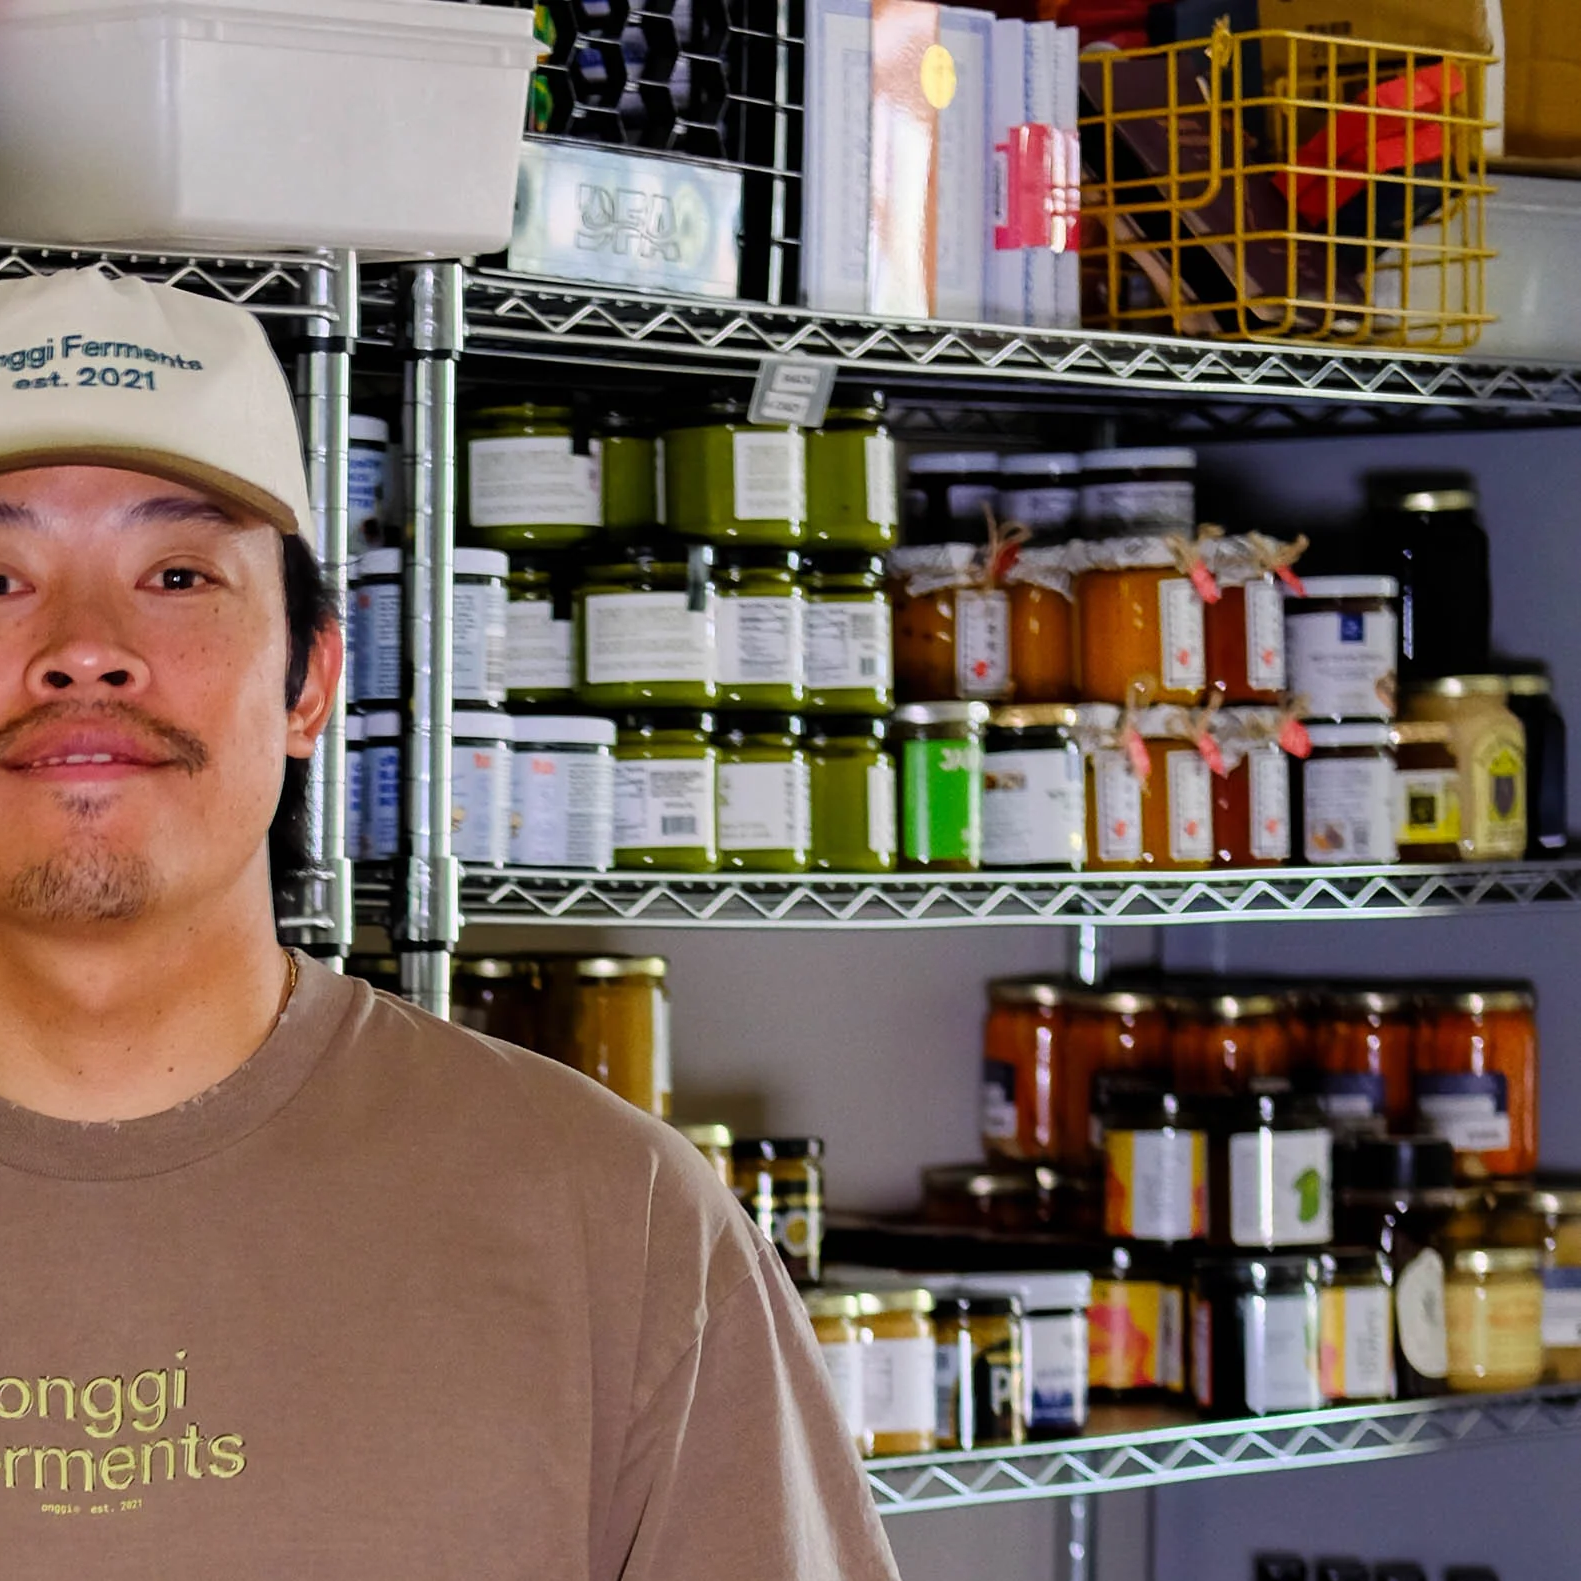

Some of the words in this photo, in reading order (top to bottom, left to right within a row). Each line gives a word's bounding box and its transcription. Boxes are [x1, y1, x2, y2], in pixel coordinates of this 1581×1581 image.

[61, 334, 204, 371] Ferments
[13, 371, 68, 390] est.
[76, 366, 158, 391] 2021
